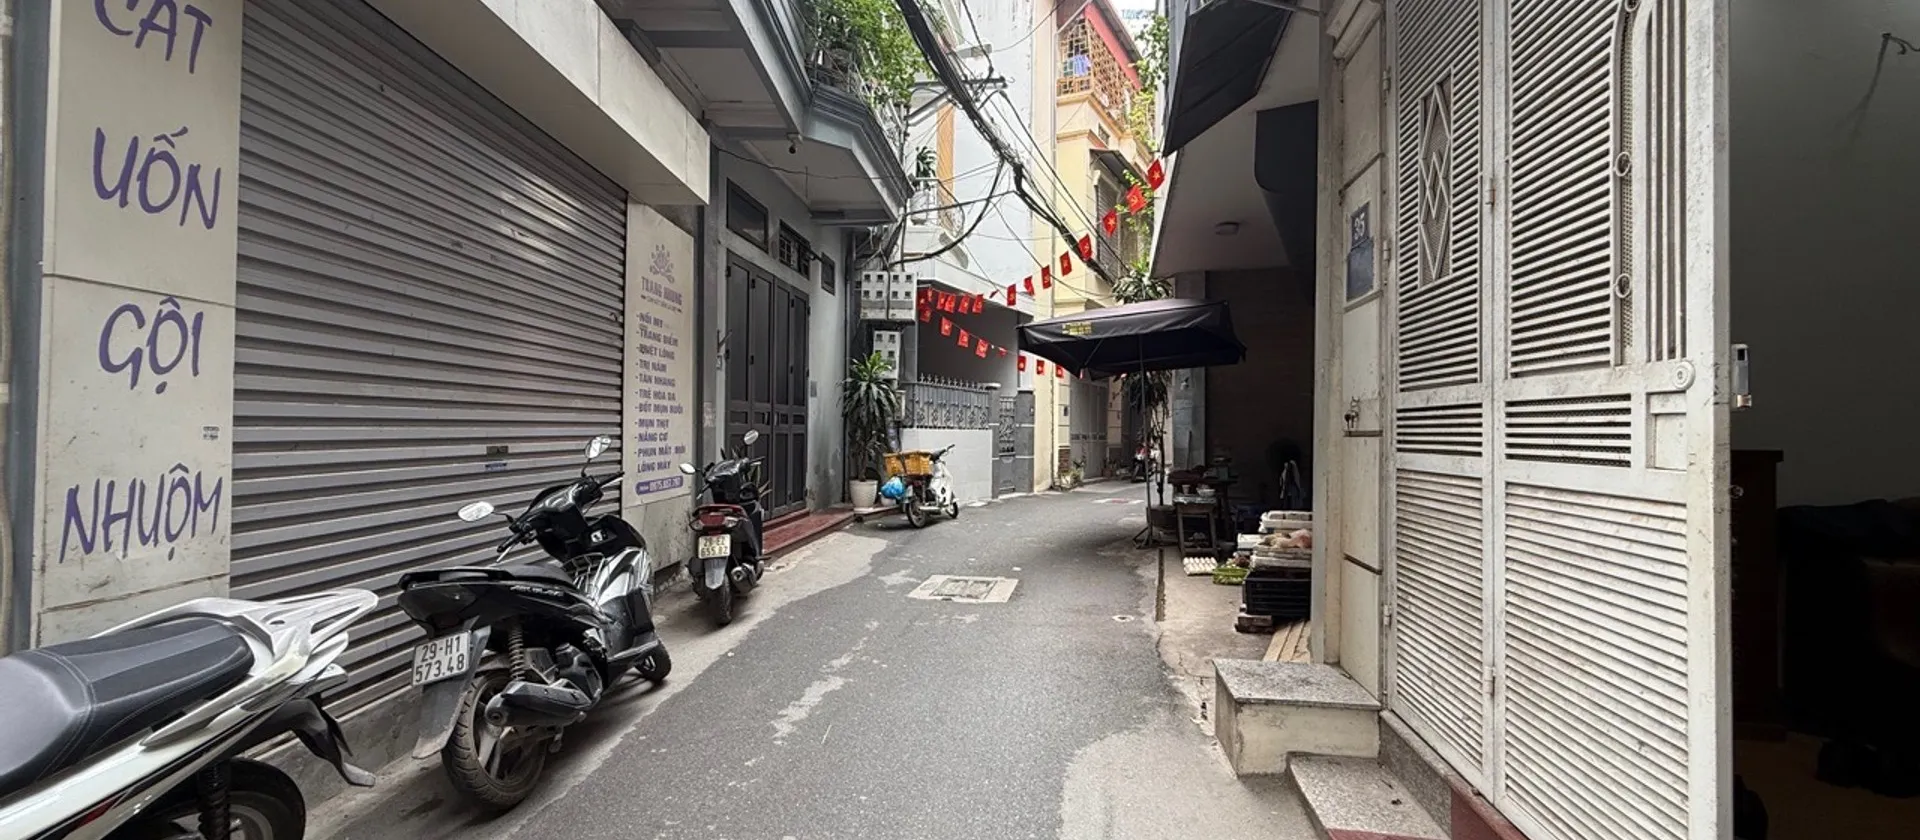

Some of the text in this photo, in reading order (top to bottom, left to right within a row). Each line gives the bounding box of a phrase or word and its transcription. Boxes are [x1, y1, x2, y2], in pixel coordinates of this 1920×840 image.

[92, 126, 221, 229] UỐN
[99, 296, 204, 394] GỘI
[59, 462, 223, 562] NHUỘM
[415, 653, 465, 682] 573.48
[420, 636, 461, 662] 29-H1
